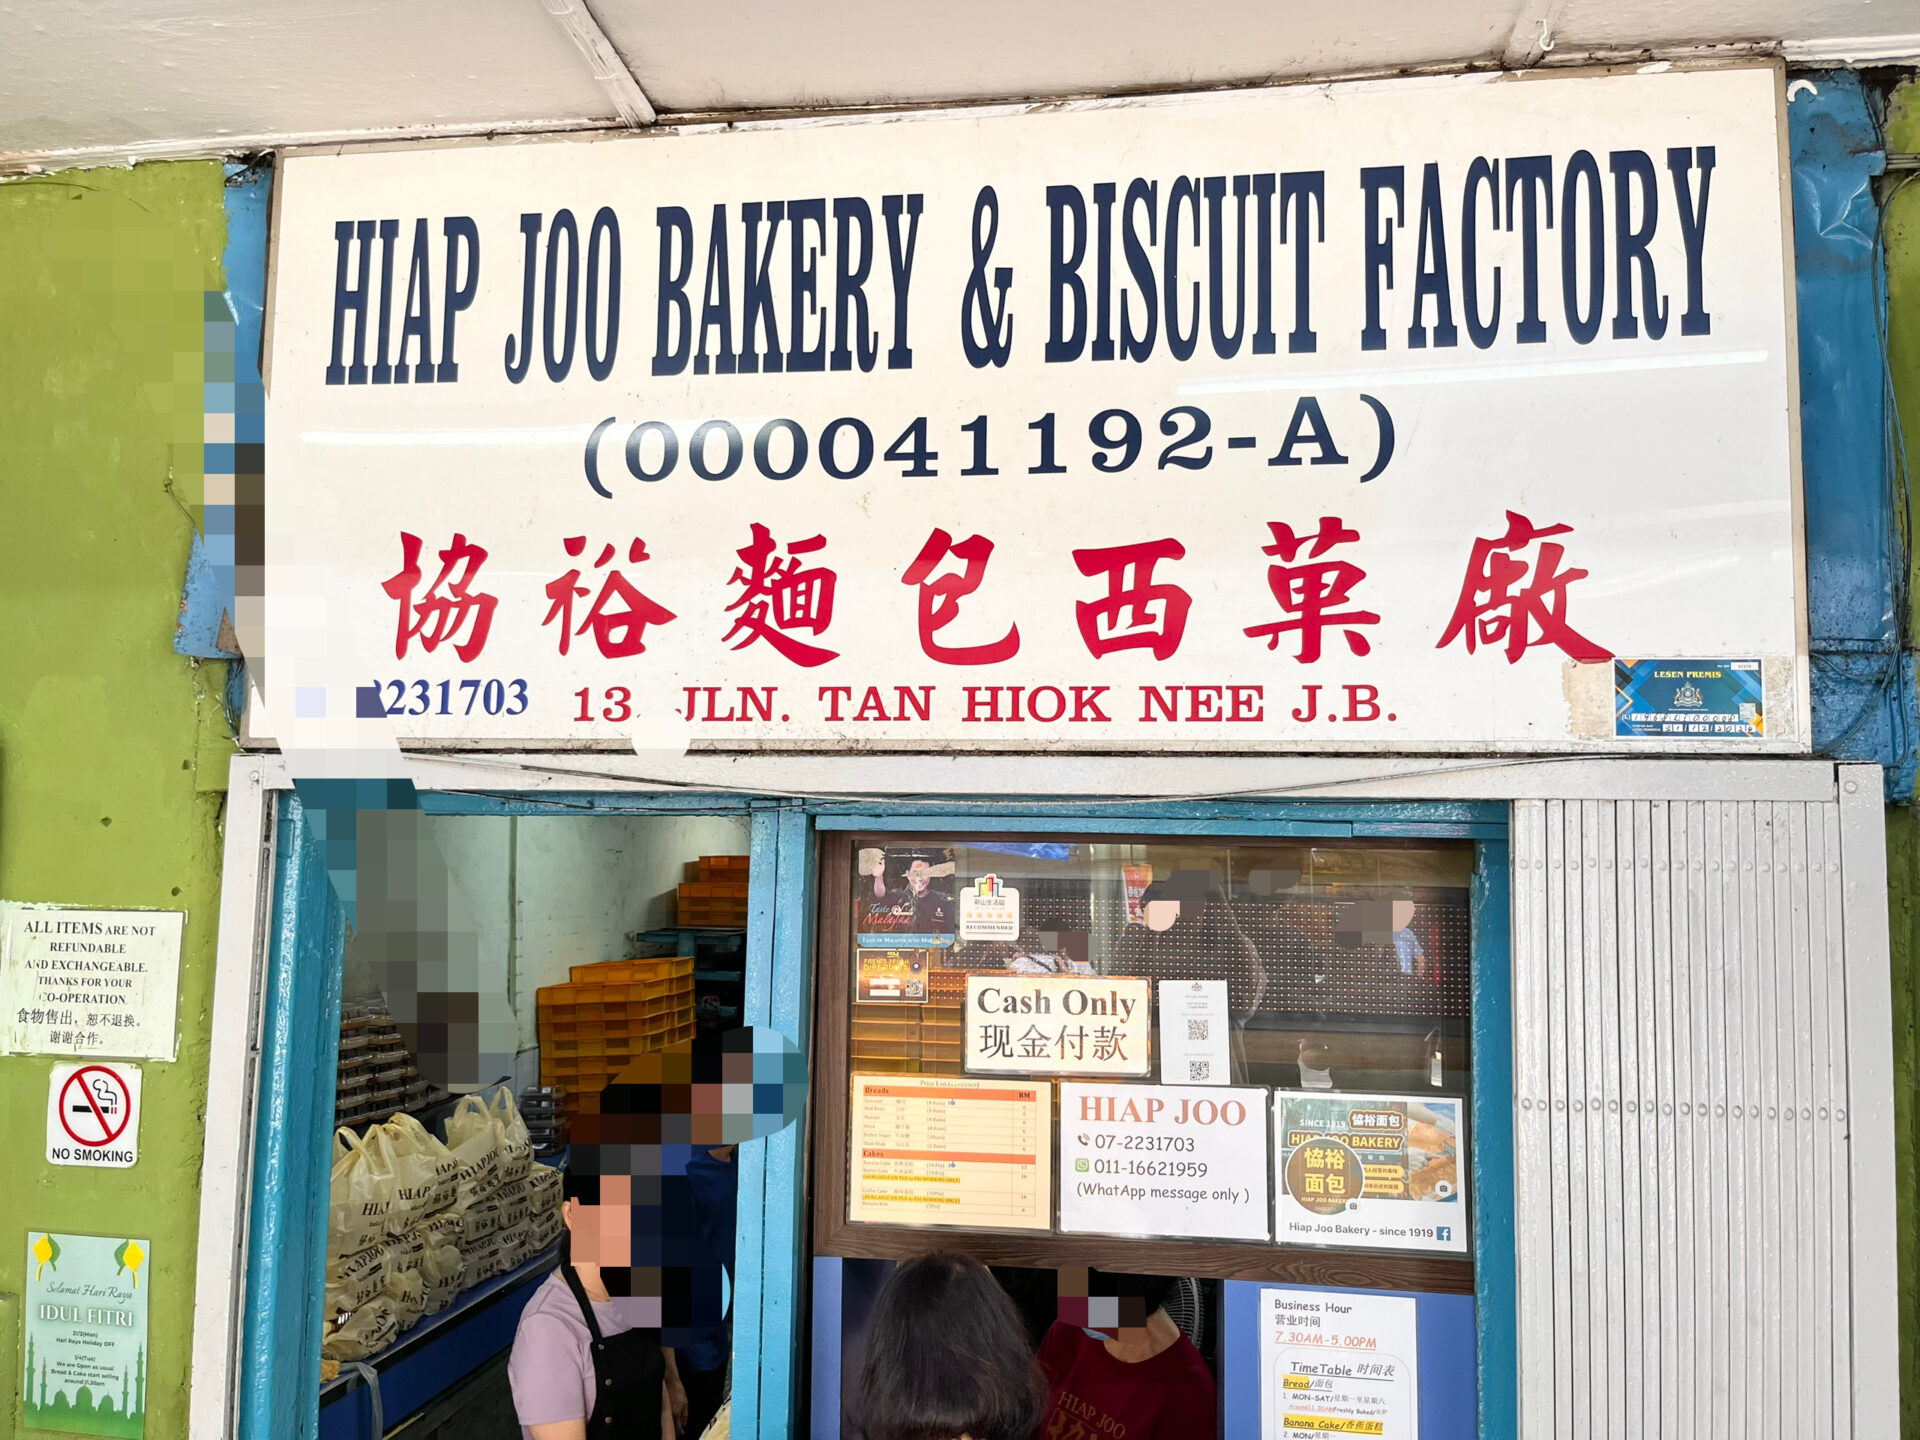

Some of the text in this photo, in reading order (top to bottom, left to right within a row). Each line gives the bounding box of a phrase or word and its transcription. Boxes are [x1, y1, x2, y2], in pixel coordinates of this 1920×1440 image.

[325, 146, 1715, 385] HIAP JOO BAKERY & BISCUIT FACTORY
[584, 394, 1396, 499] (00041192-A)
[675, 685, 790, 723] JLN.
[818, 685, 935, 722] TAN
[961, 685, 1112, 722] HIOK
[1139, 685, 1264, 723] NEE
[1292, 685, 1398, 723] J.B.
[24, 921, 156, 936] ALL ITEMS ARE NOT
[50, 942, 126, 954] REFUNDABLE
[25, 960, 148, 973] AND EXCHANGEABLE.
[38, 976, 132, 988] THANKS FOR YOUR
[978, 987, 1137, 1023] Cash Only
[979, 1024, 1129, 1061] 现金付款
[1078, 1096, 1246, 1126] HIAP JOO
[1300, 1118, 1346, 1128] SINCE 1919
[1095, 1134, 1195, 1152] 07-2231703
[1352, 1136, 1401, 1148] BAKERY
[52, 1147, 133, 1163] NO SMOKING
[863, 1150, 884, 1158] Cakes
[1094, 1159, 1208, 1178] 011-16621959
[1304, 1173, 1346, 1194] 面包
[1077, 1182, 1146, 1200] (WhatApp
[1151, 1187, 1208, 1202] message
[1212, 1187, 1239, 1204] only
[1289, 1222, 1311, 1236] Hiap
[1314, 1223, 1333, 1234] Joo
[1335, 1225, 1370, 1237] Bakery
[1379, 1226, 1406, 1236] since
[1409, 1228, 1434, 1237] 1919
[46, 1281, 133, 1304] Selamat Hari Raya
[1274, 1299, 1352, 1314] Business Hour
[40, 1304, 133, 1327] IDUL FITRI
[1274, 1315, 1321, 1327] 营业时间
[1275, 1331, 1377, 1349] 7.30AM-5.00PM
[101, 1373, 119, 1381] selling
[1291, 1362, 1395, 1377] TimeTable 时间表
[1058, 1391, 1096, 1420] HIAP
[1096, 1414, 1126, 1439] JOO
[1283, 1418, 1314, 1428] Banana
